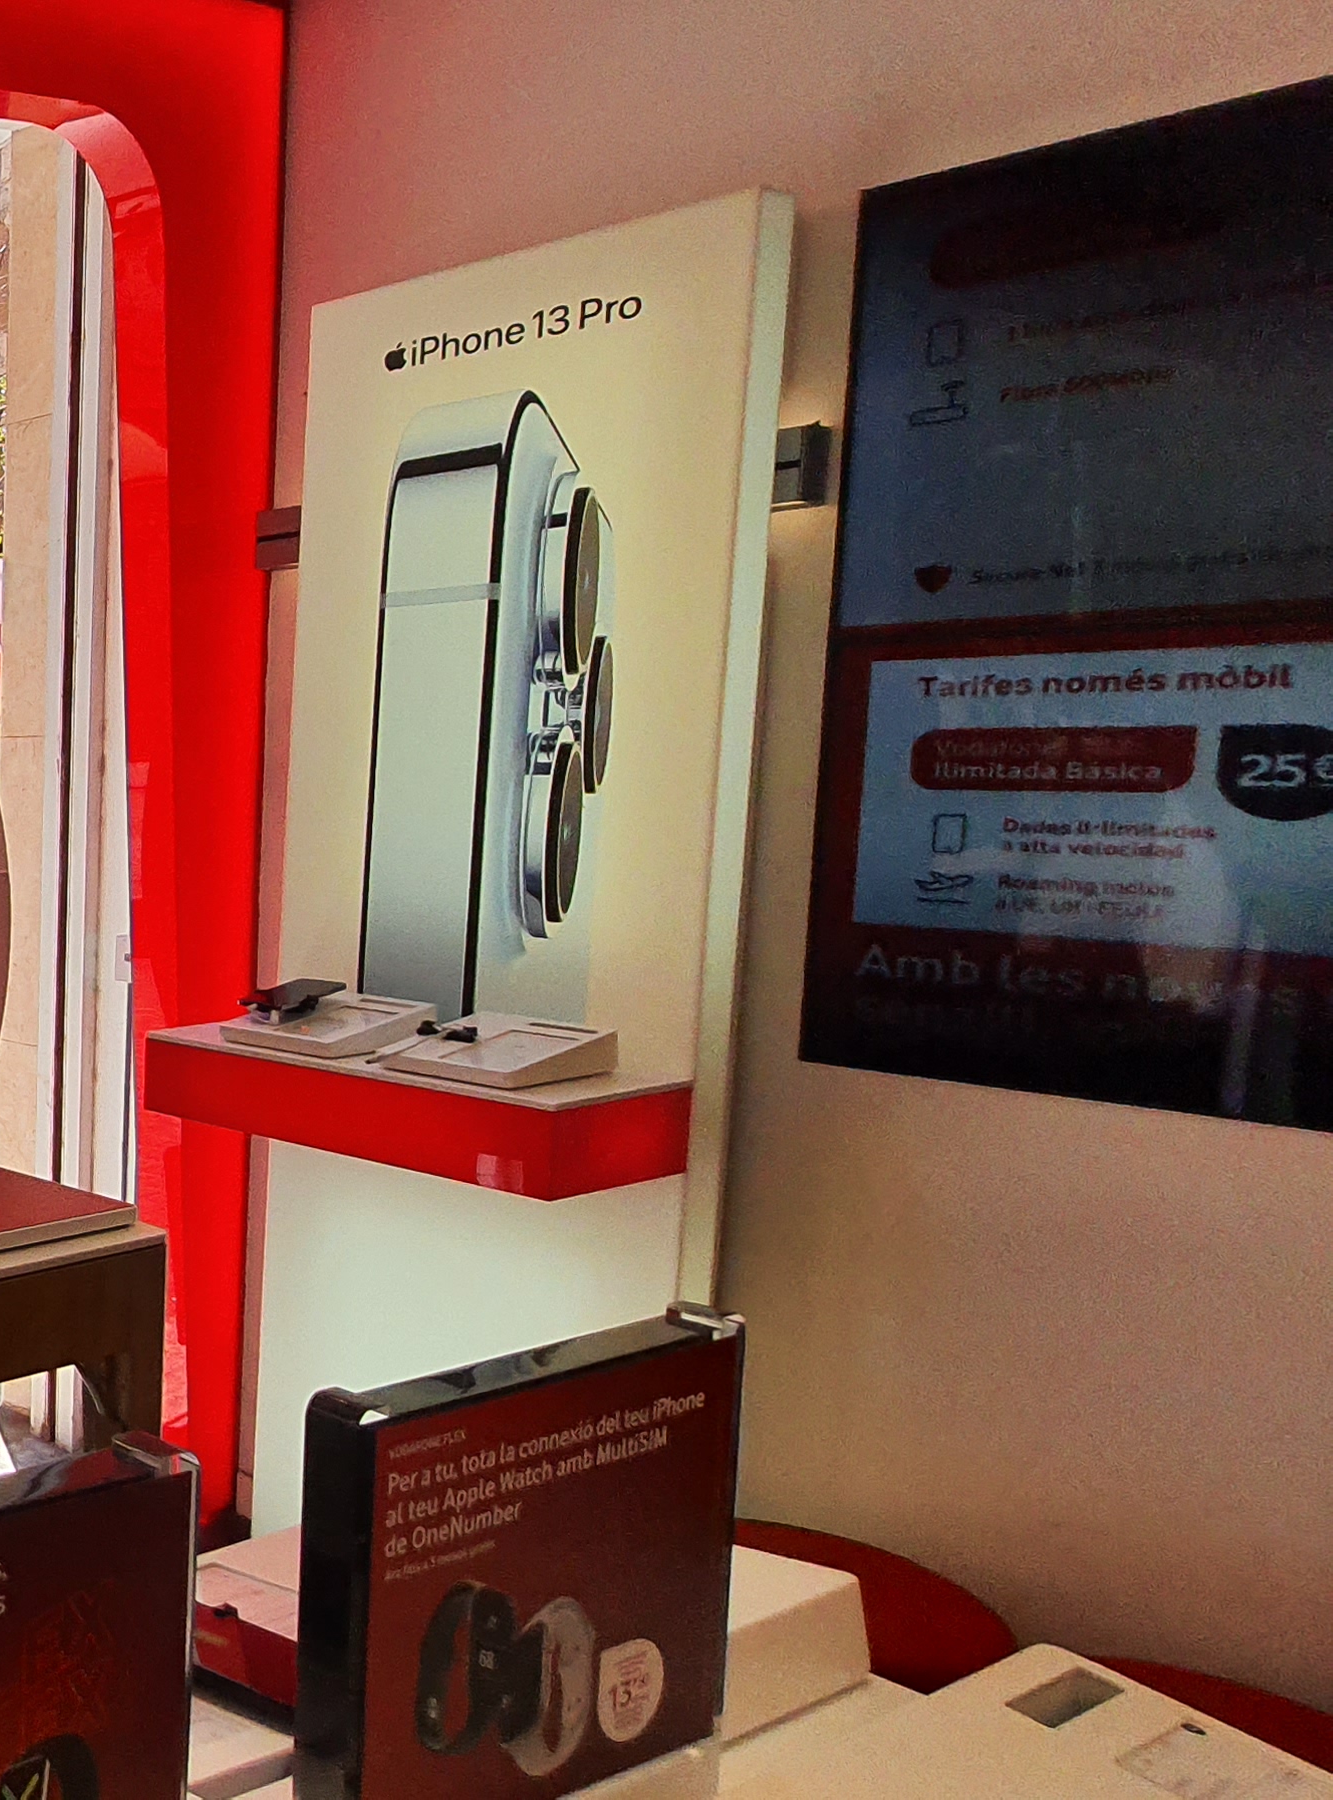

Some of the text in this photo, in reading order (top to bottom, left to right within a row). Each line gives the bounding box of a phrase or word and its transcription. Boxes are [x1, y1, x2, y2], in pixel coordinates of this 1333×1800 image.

[410, 296, 643, 367] iPhone 13 Pro
[918, 663, 1292, 698] Tarifes només mòbil
[854, 943, 981, 985] Amb
[387, 1470, 419, 1496] Per
[420, 1468, 431, 1486] a
[461, 1450, 496, 1477] tota
[499, 1442, 516, 1465] la
[518, 1419, 594, 1460] connexió
[596, 1409, 621, 1437] del
[623, 1407, 650, 1429] teu
[652, 1391, 706, 1421] iPhone
[385, 1424, 669, 1529] al teu Apple Watch amb MultiSIM
[383, 1533, 408, 1559] de
[411, 1501, 523, 1550] OneNumber
